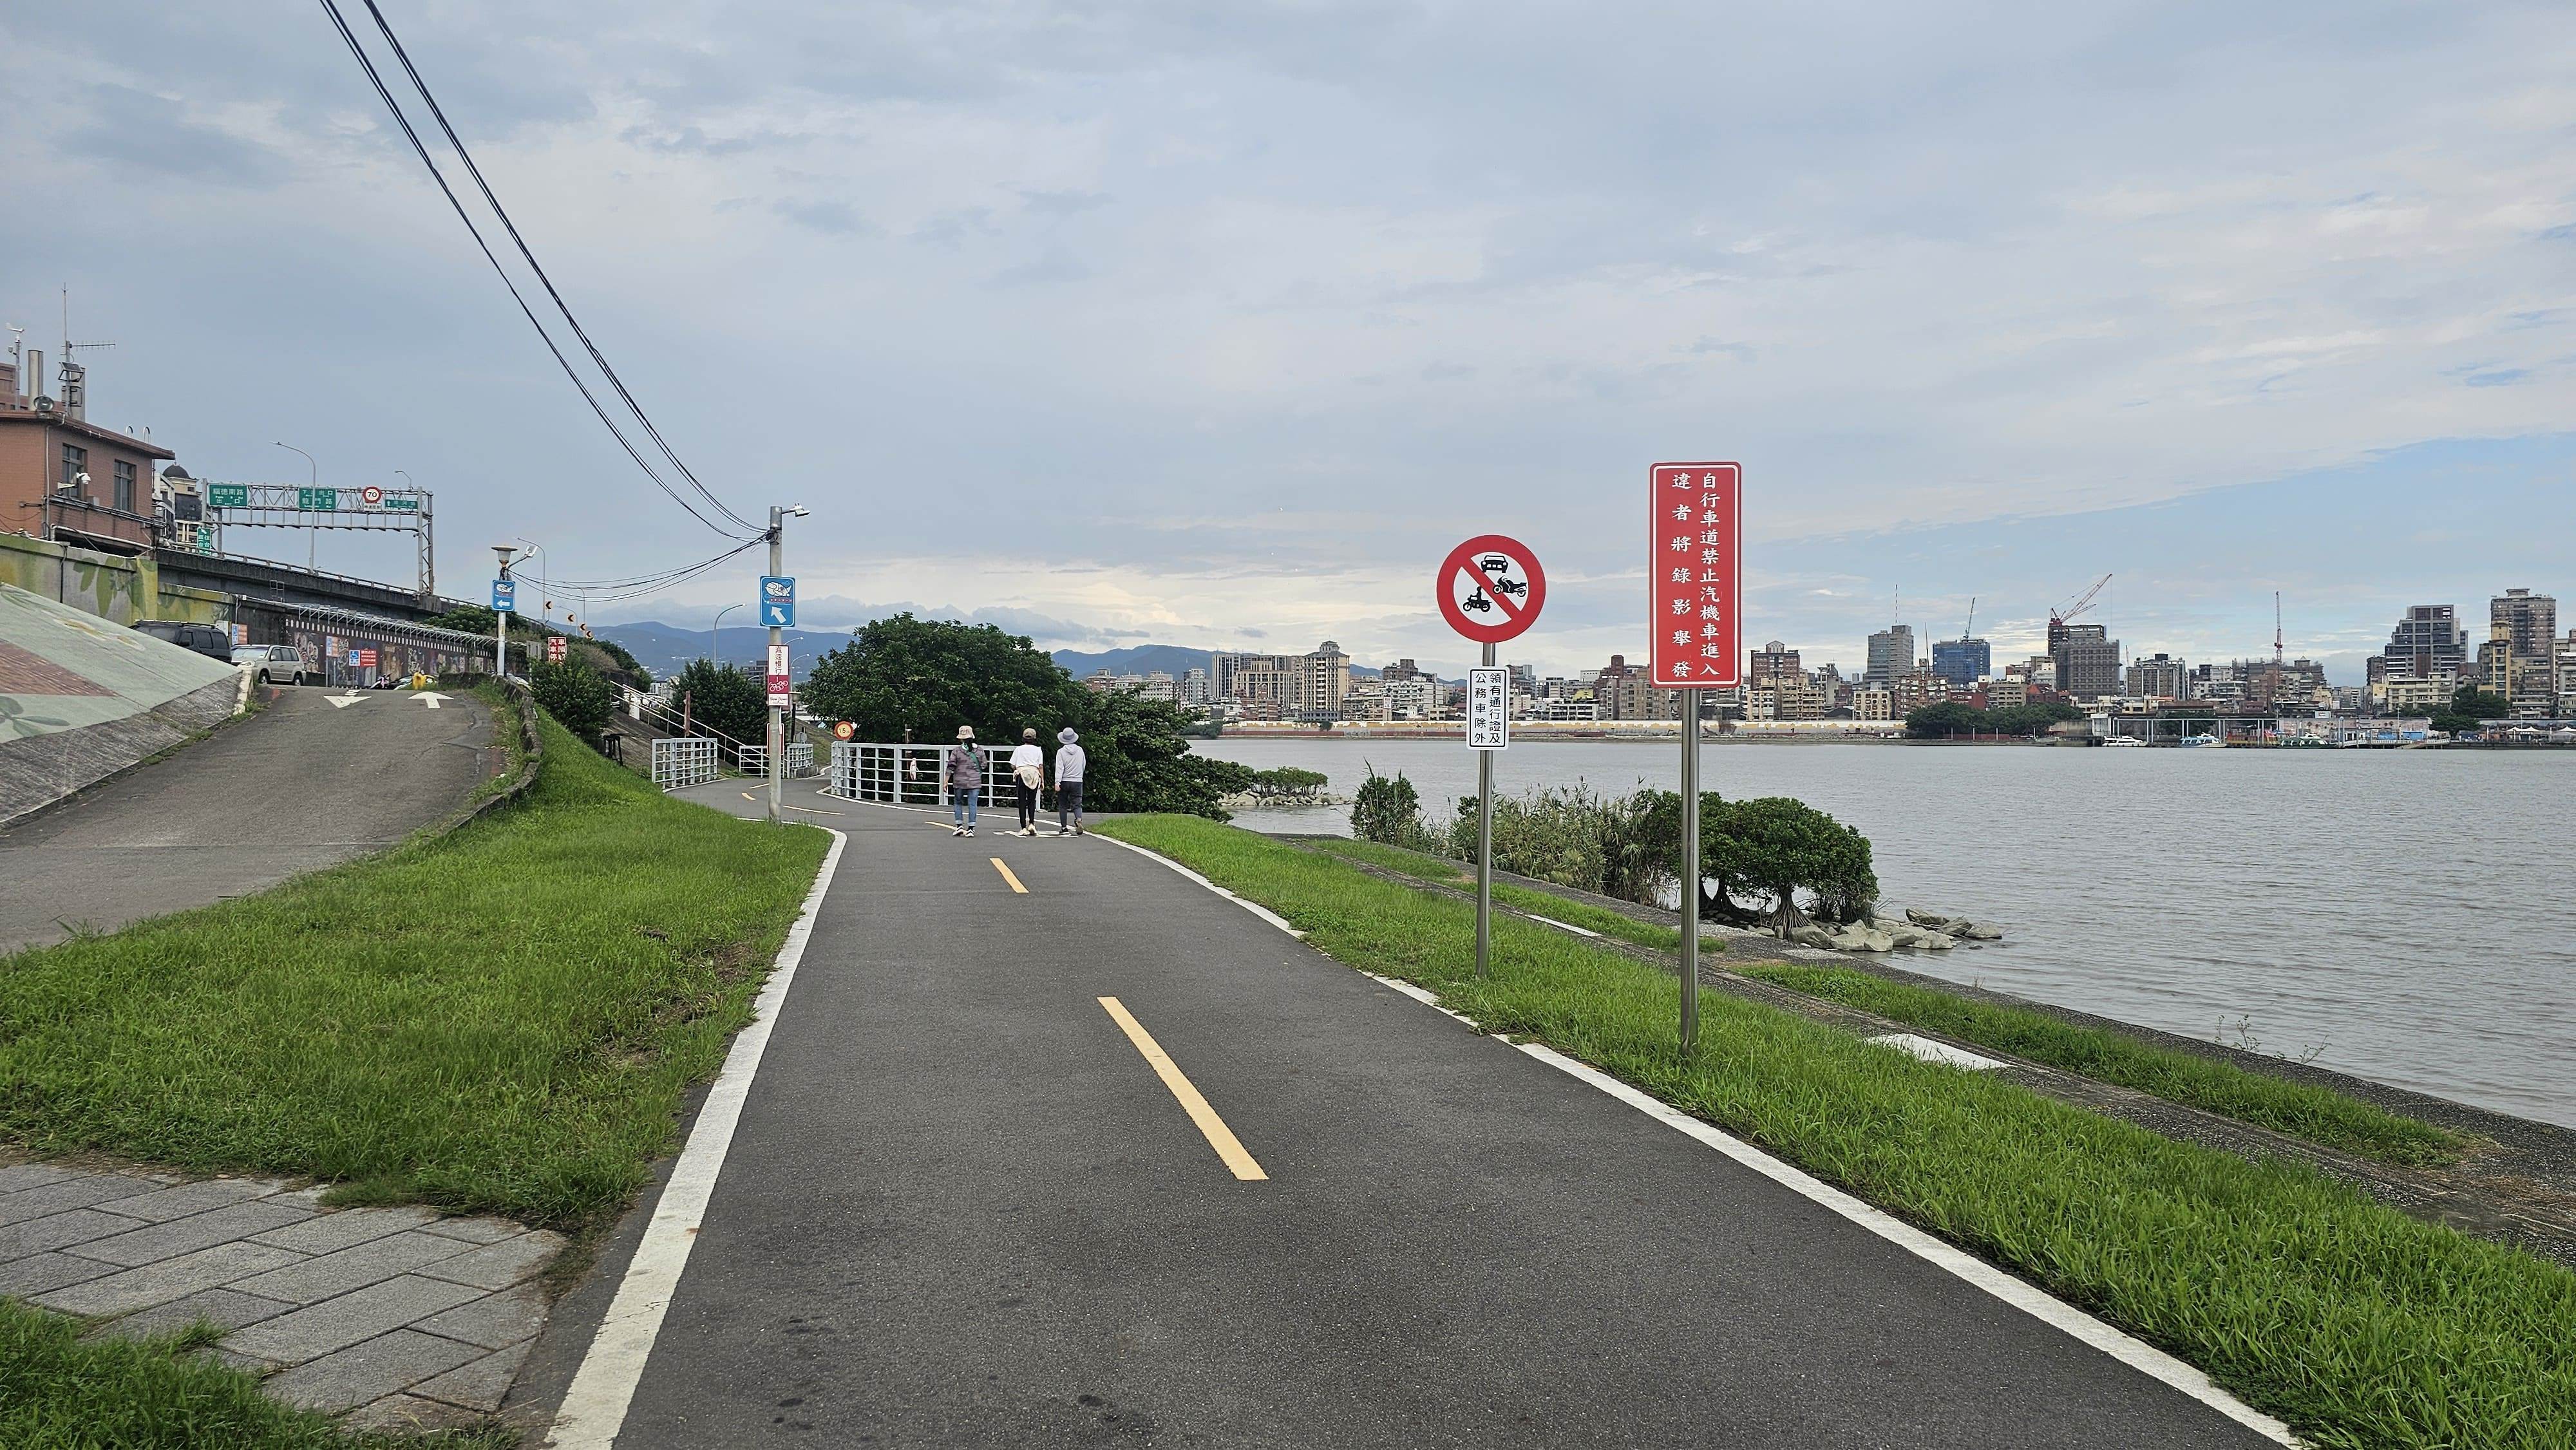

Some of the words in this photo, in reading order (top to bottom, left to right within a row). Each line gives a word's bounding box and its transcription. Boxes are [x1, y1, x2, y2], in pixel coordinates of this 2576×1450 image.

[1671, 472, 1692, 677] 違者將錄影舉發
[1700, 473, 1720, 675] 自行車道禁止汽機車進入
[1474, 673, 1486, 743] 公務車除外
[1489, 673, 1501, 743] 領有通行證及
